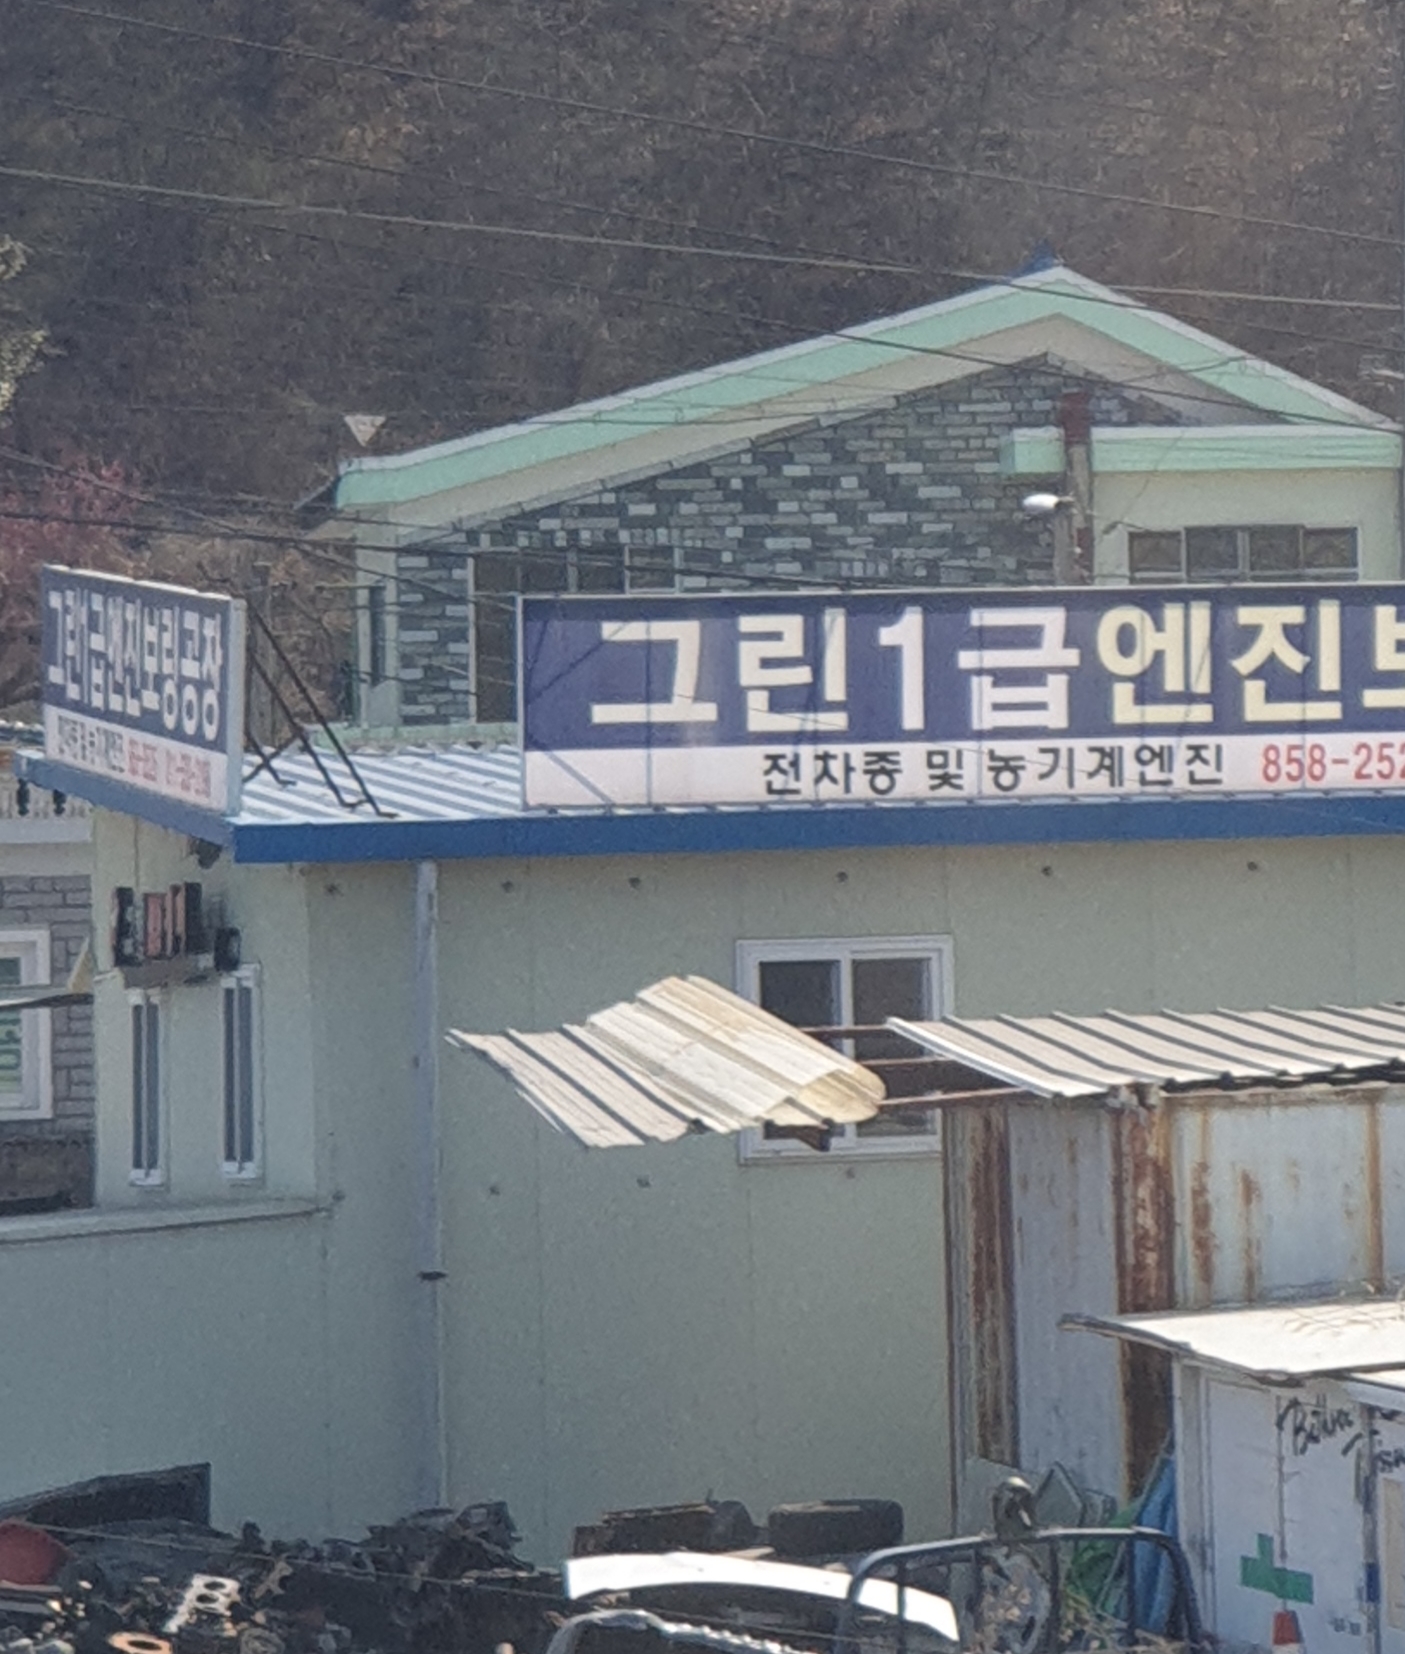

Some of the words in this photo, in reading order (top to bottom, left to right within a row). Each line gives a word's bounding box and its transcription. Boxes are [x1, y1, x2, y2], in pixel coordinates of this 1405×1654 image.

[762, 750, 903, 796] 전차종
[925, 747, 966, 791] 및
[986, 743, 1223, 790] 농기계엔진
